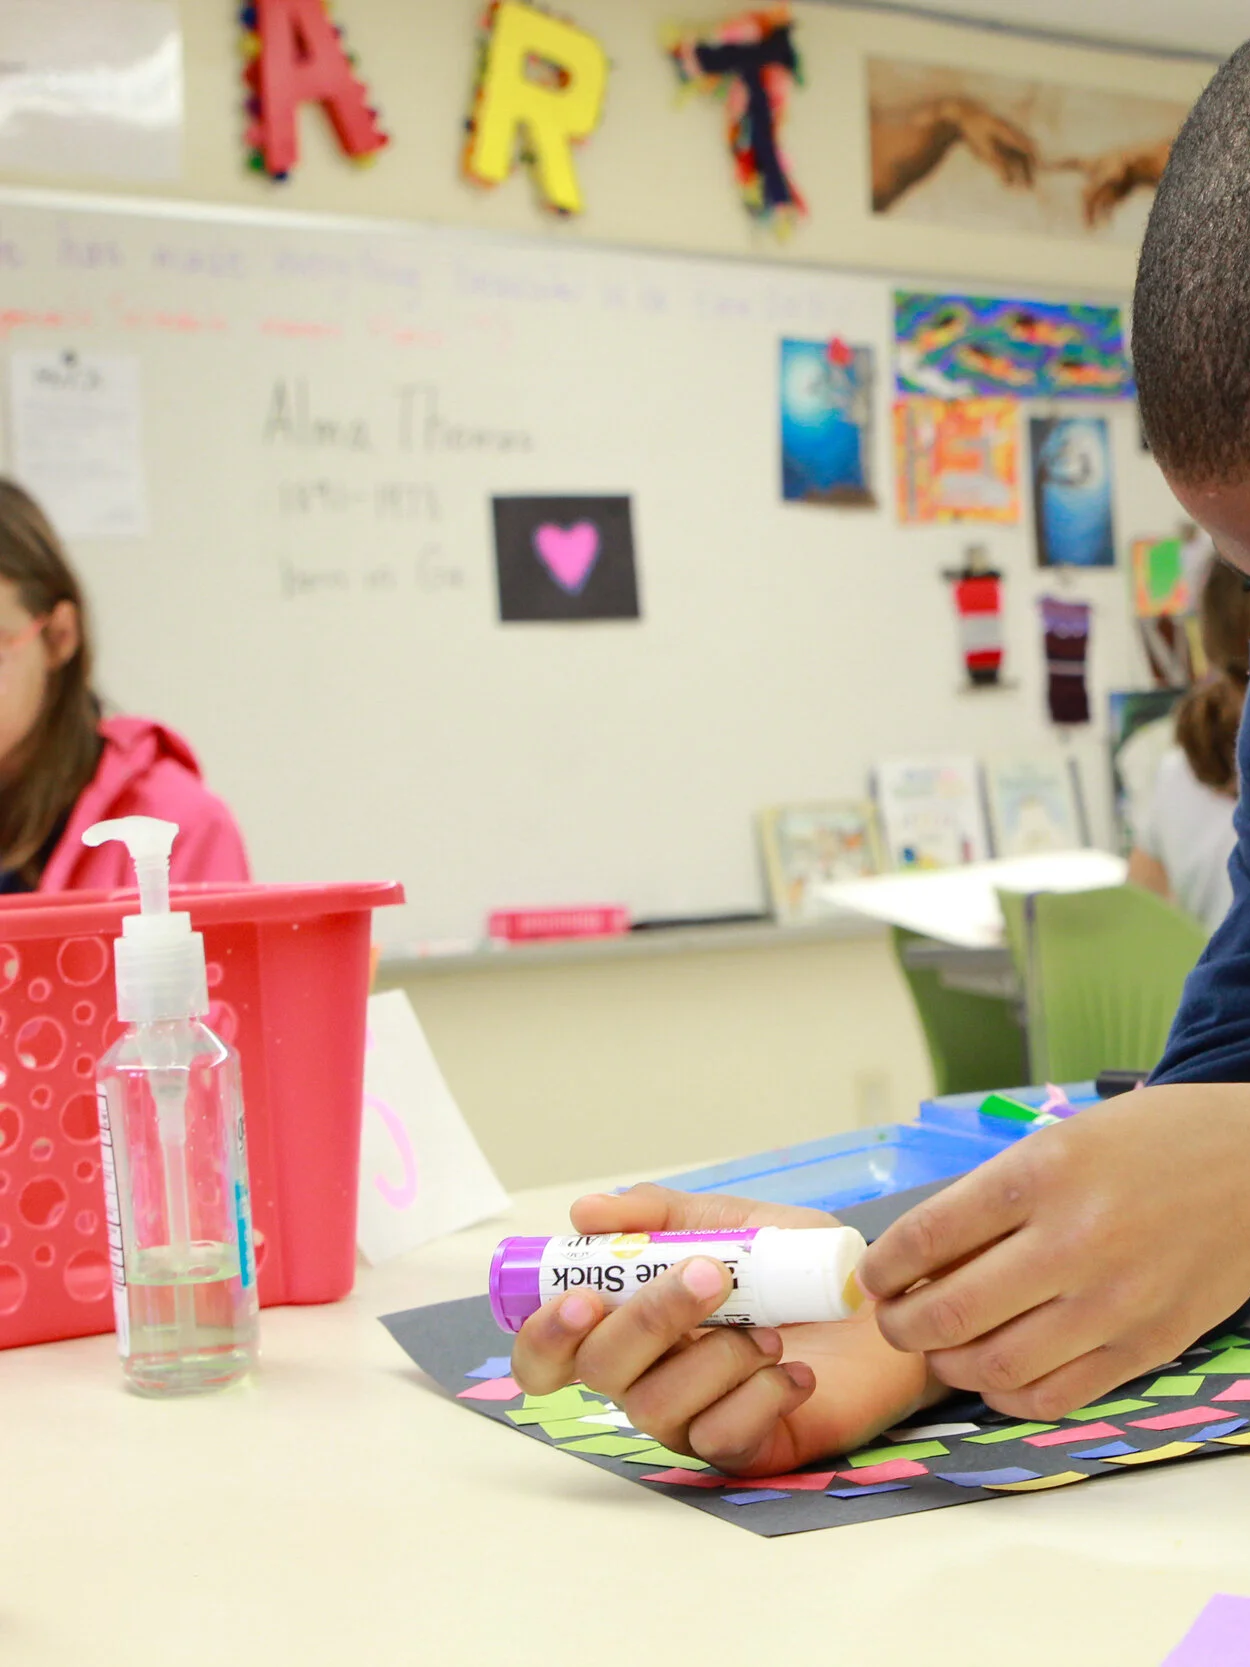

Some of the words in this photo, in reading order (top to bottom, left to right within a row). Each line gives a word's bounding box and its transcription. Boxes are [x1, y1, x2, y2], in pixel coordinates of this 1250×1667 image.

[243, 0, 806, 232] ART
[262, 375, 371, 453] Alma
[392, 382, 534, 454] Thomas
[551, 1264, 625, 1293] Stick
